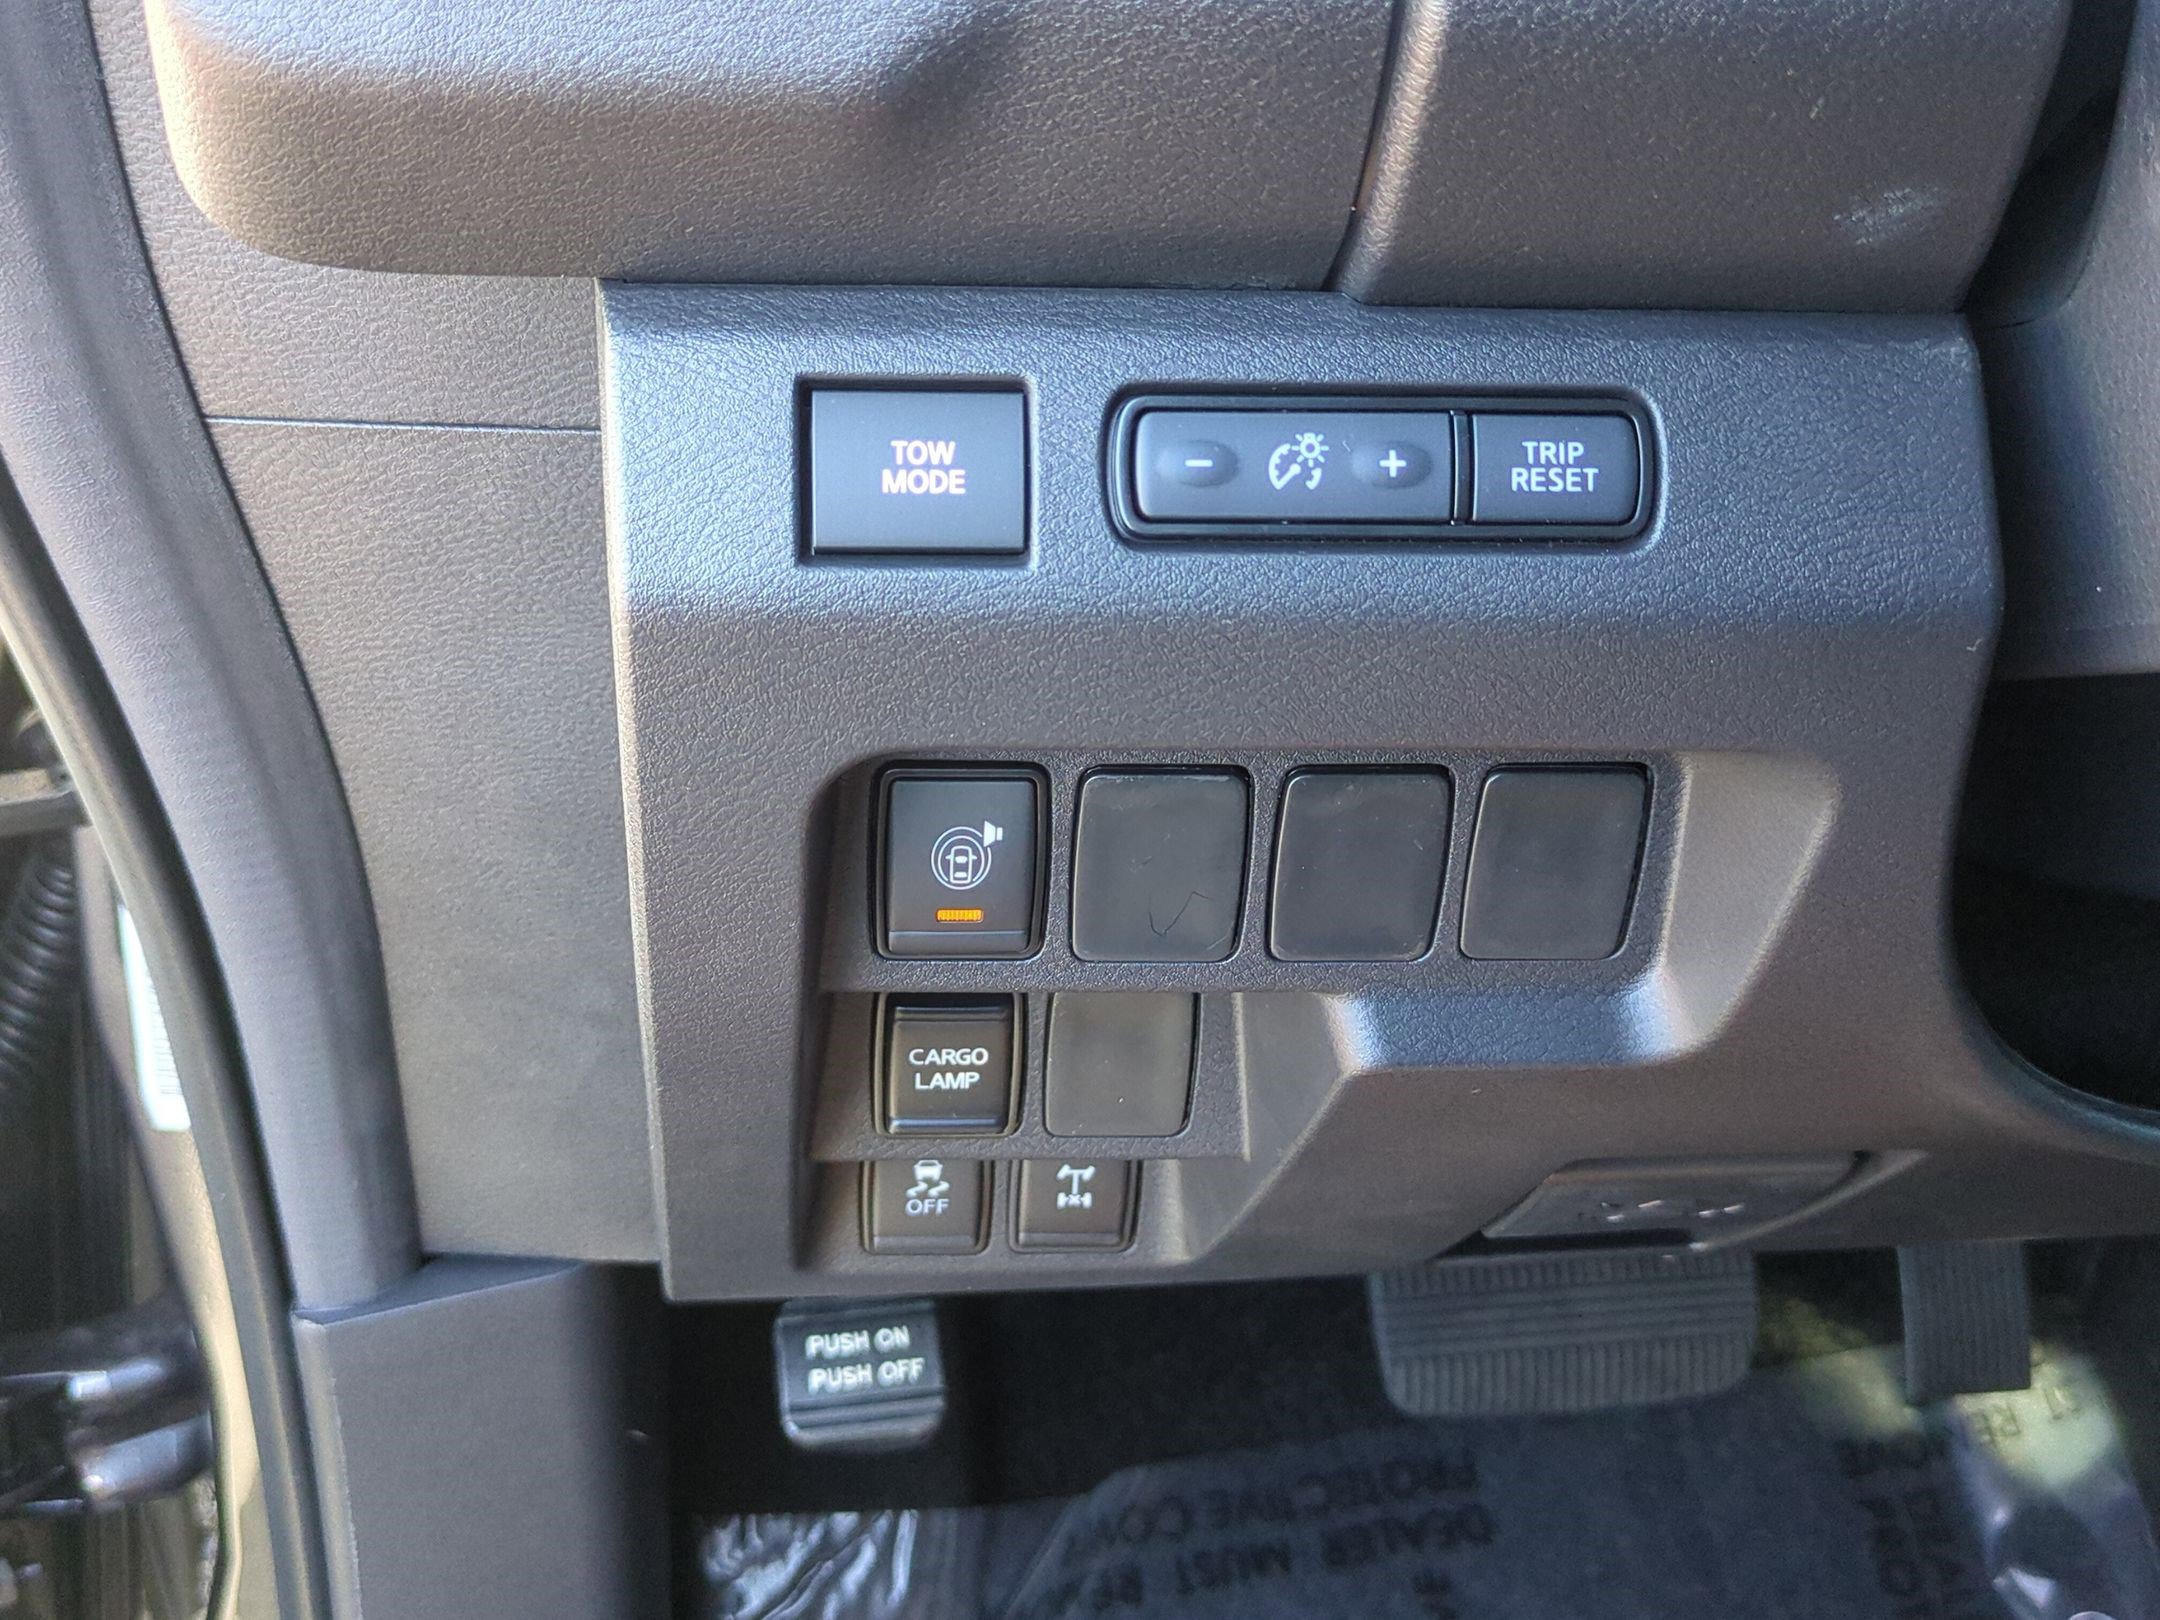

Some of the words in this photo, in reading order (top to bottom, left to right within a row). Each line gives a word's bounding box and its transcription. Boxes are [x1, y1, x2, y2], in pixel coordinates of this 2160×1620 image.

[890, 440, 956, 465] TOW
[1521, 440, 1585, 465] TRIP
[881, 468, 967, 495] MODE
[1510, 466, 1599, 492] RESET
[908, 1047, 989, 1066] CARGO
[914, 1072, 981, 1091] LAMP
[905, 1199, 950, 1217] OFF
[805, 1331, 870, 1359] PUSH
[874, 1325, 910, 1352] ON
[808, 1367, 873, 1394] PUSH
[876, 1357, 925, 1387] OFF
